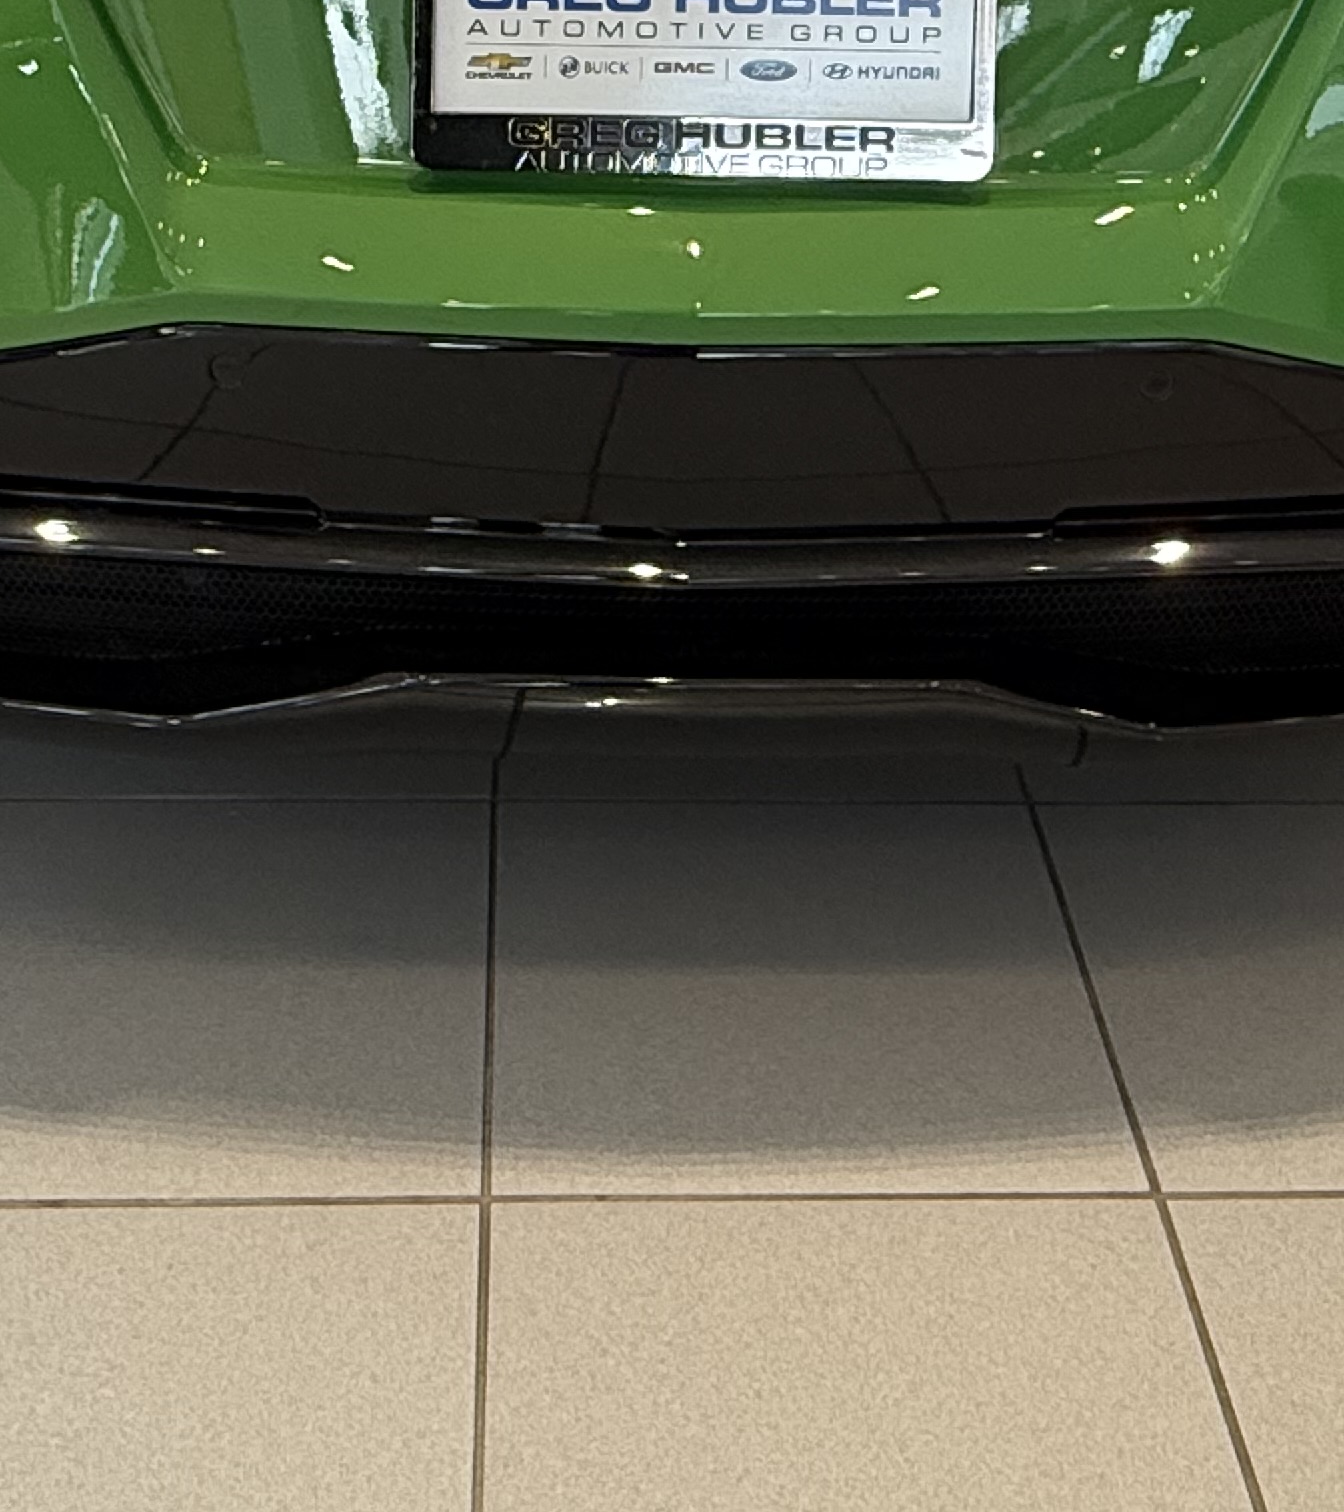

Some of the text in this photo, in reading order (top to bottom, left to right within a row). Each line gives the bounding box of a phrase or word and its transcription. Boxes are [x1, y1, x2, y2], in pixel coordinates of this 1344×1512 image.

[466, 18, 942, 44] AUTOMOTIVE GROUP
[584, 60, 630, 75] BUICK
[654, 61, 715, 74] GMC
[750, 61, 786, 78] Ford
[857, 65, 942, 81] HYUNDAI
[508, 117, 896, 153] GREG HUBLER
[514, 149, 889, 178] AUTOMOTIVE GROUP
